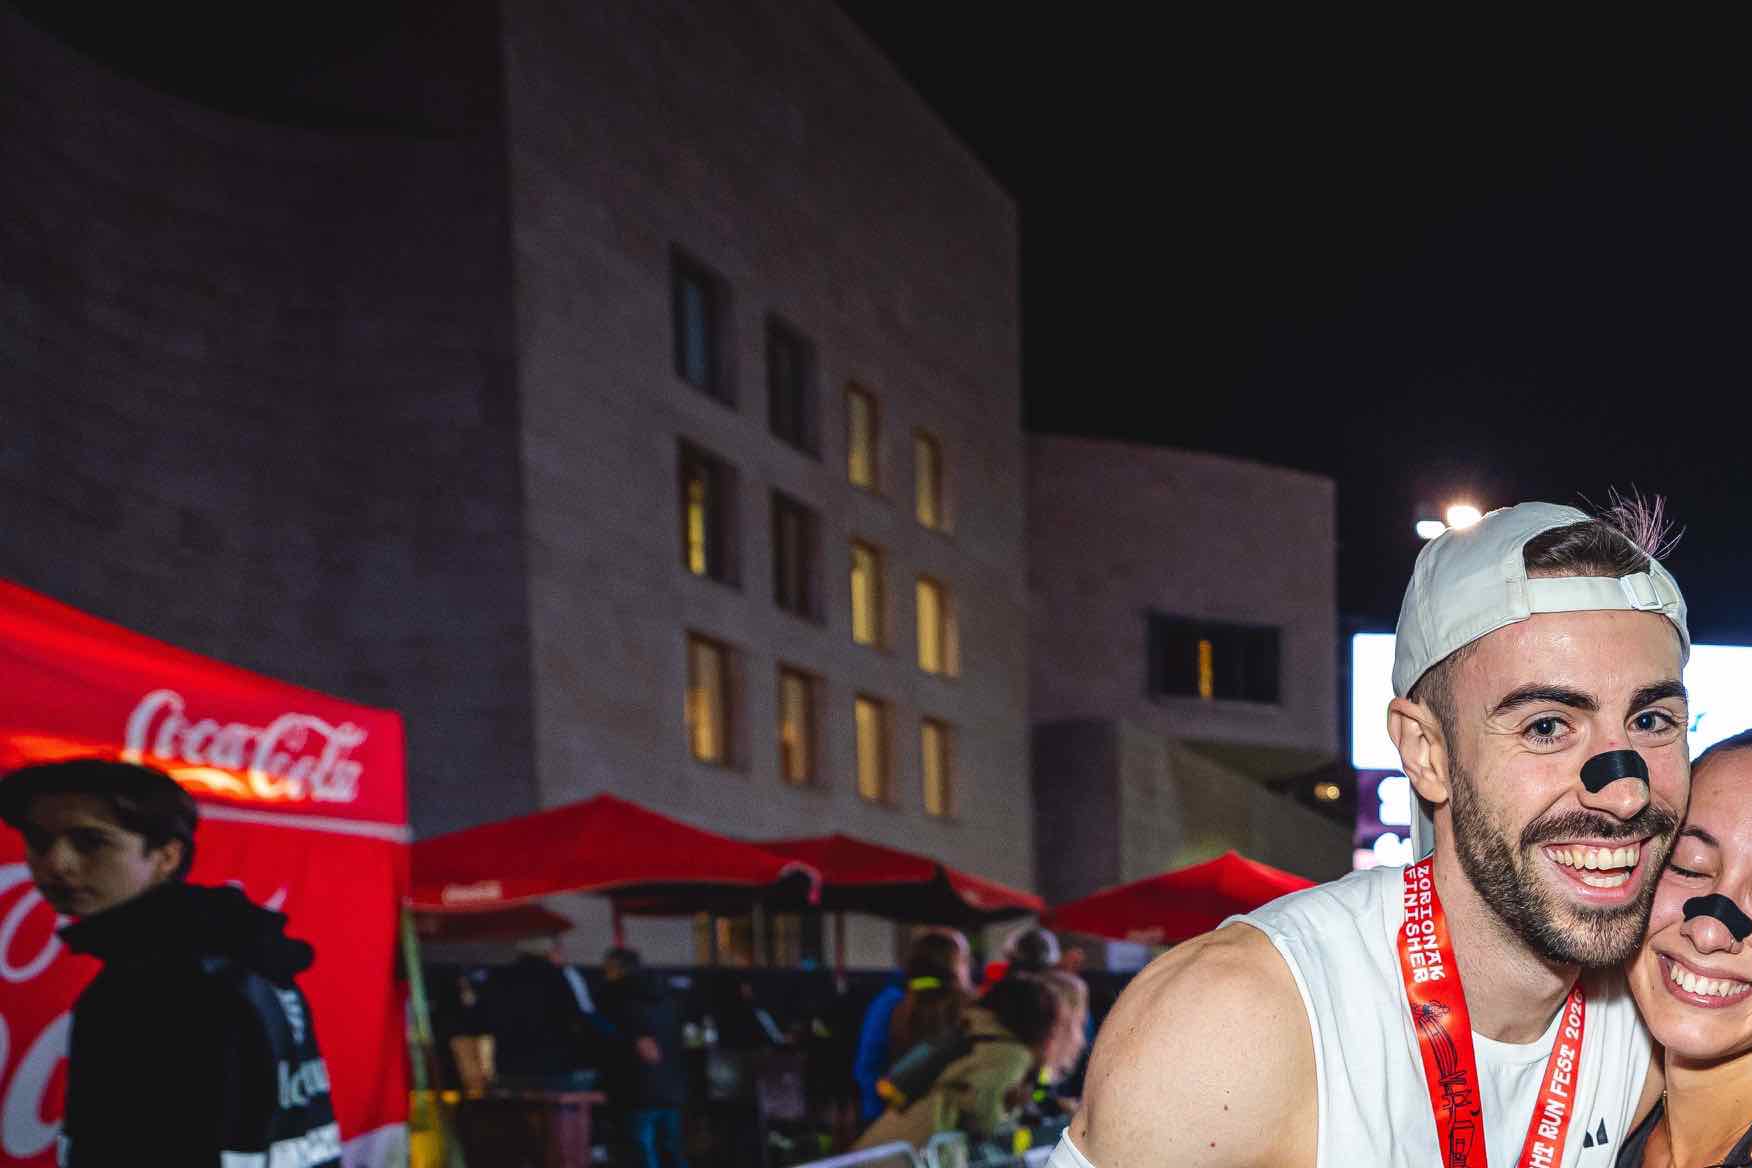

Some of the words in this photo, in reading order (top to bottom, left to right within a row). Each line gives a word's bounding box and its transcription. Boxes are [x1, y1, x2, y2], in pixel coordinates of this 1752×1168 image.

[1403, 869, 1429, 983] FINISHER
[1417, 865, 1445, 981] ZORIONAK
[1550, 1045, 1578, 1098] FEST
[1538, 1098, 1564, 1140] RUN
